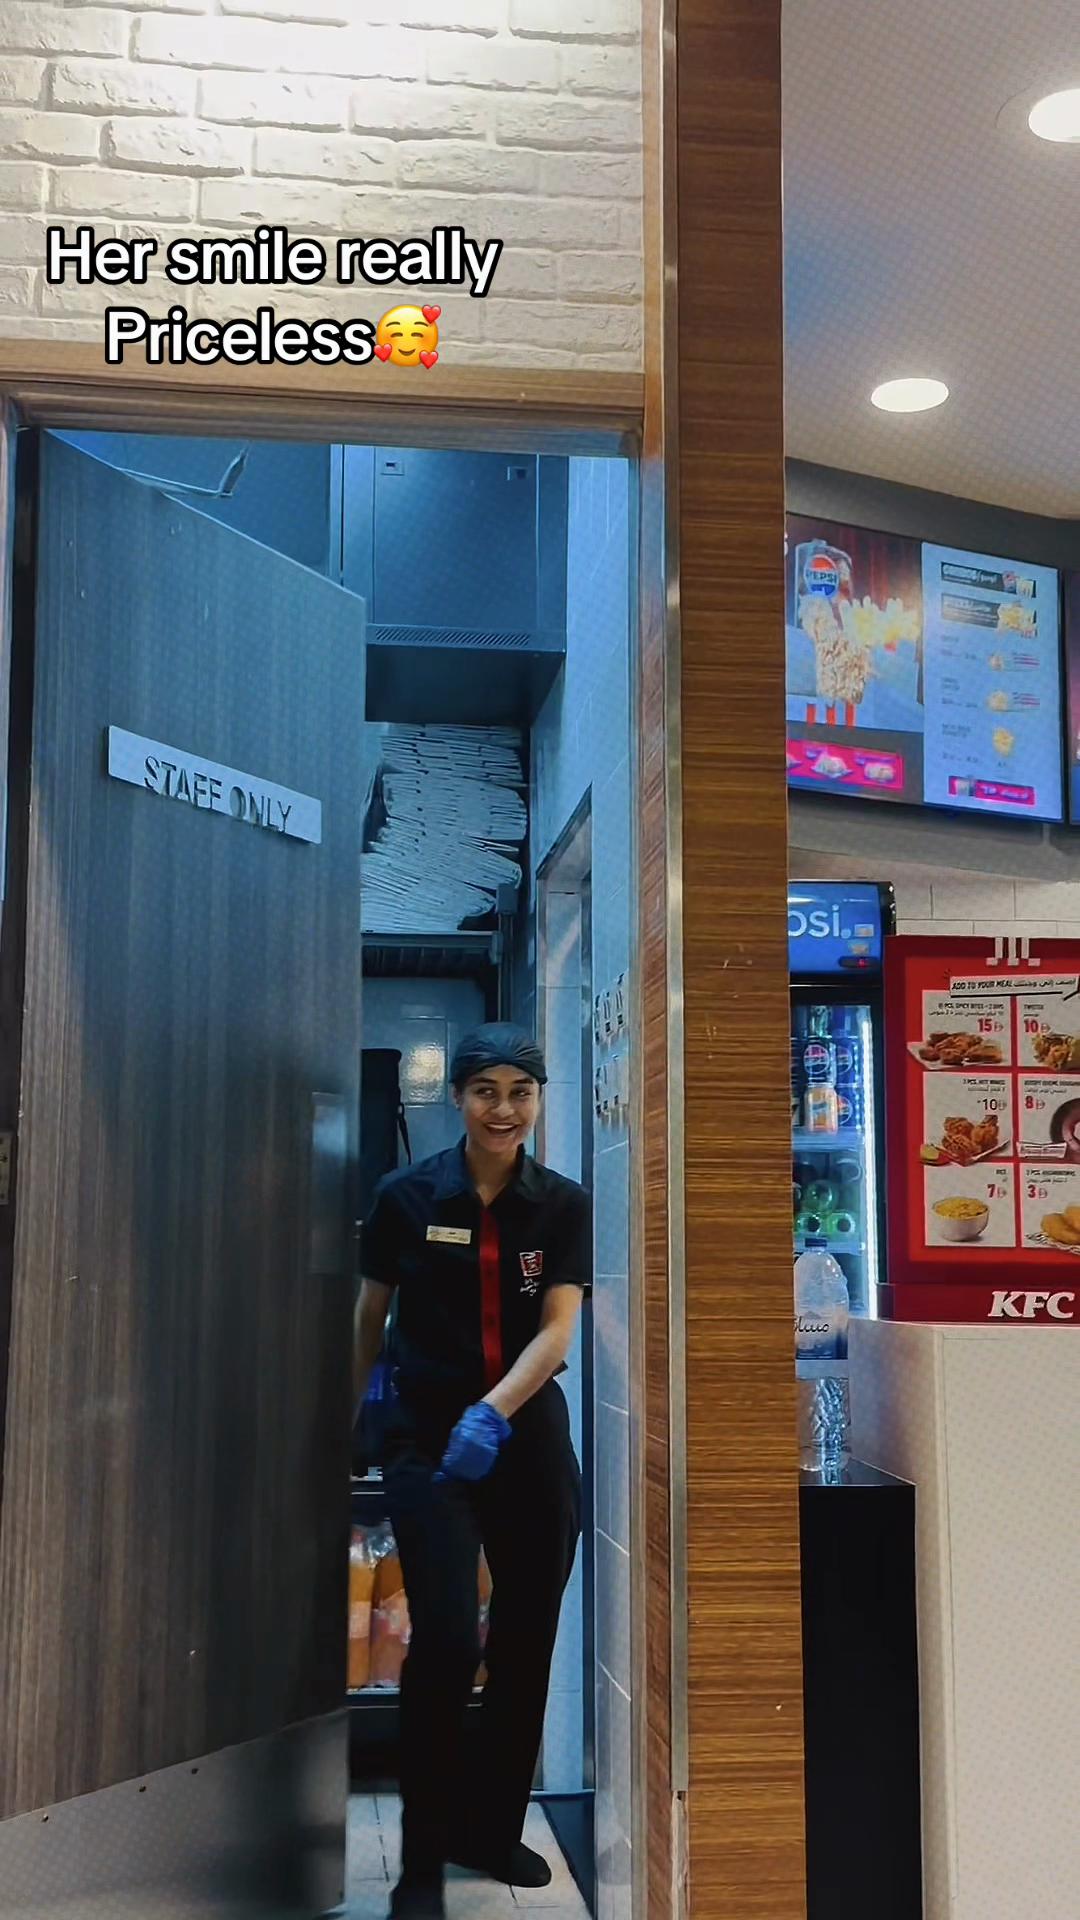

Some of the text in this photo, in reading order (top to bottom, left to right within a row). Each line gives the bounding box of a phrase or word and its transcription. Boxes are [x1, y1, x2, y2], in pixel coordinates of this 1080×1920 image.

[805, 568, 837, 585] PEPSI
[144, 755, 292, 833] STAFF ONLY
[951, 979, 1013, 990] ADD TO YOUR MEAL
[978, 1018, 993, 1033] 15
[1023, 1019, 1039, 1033] 10
[982, 1098, 998, 1111] 10
[1025, 1096, 1034, 1110] 8
[987, 1184, 996, 1198] 7
[1027, 1185, 1036, 1199] 3
[988, 1291, 1075, 1320] KFC
